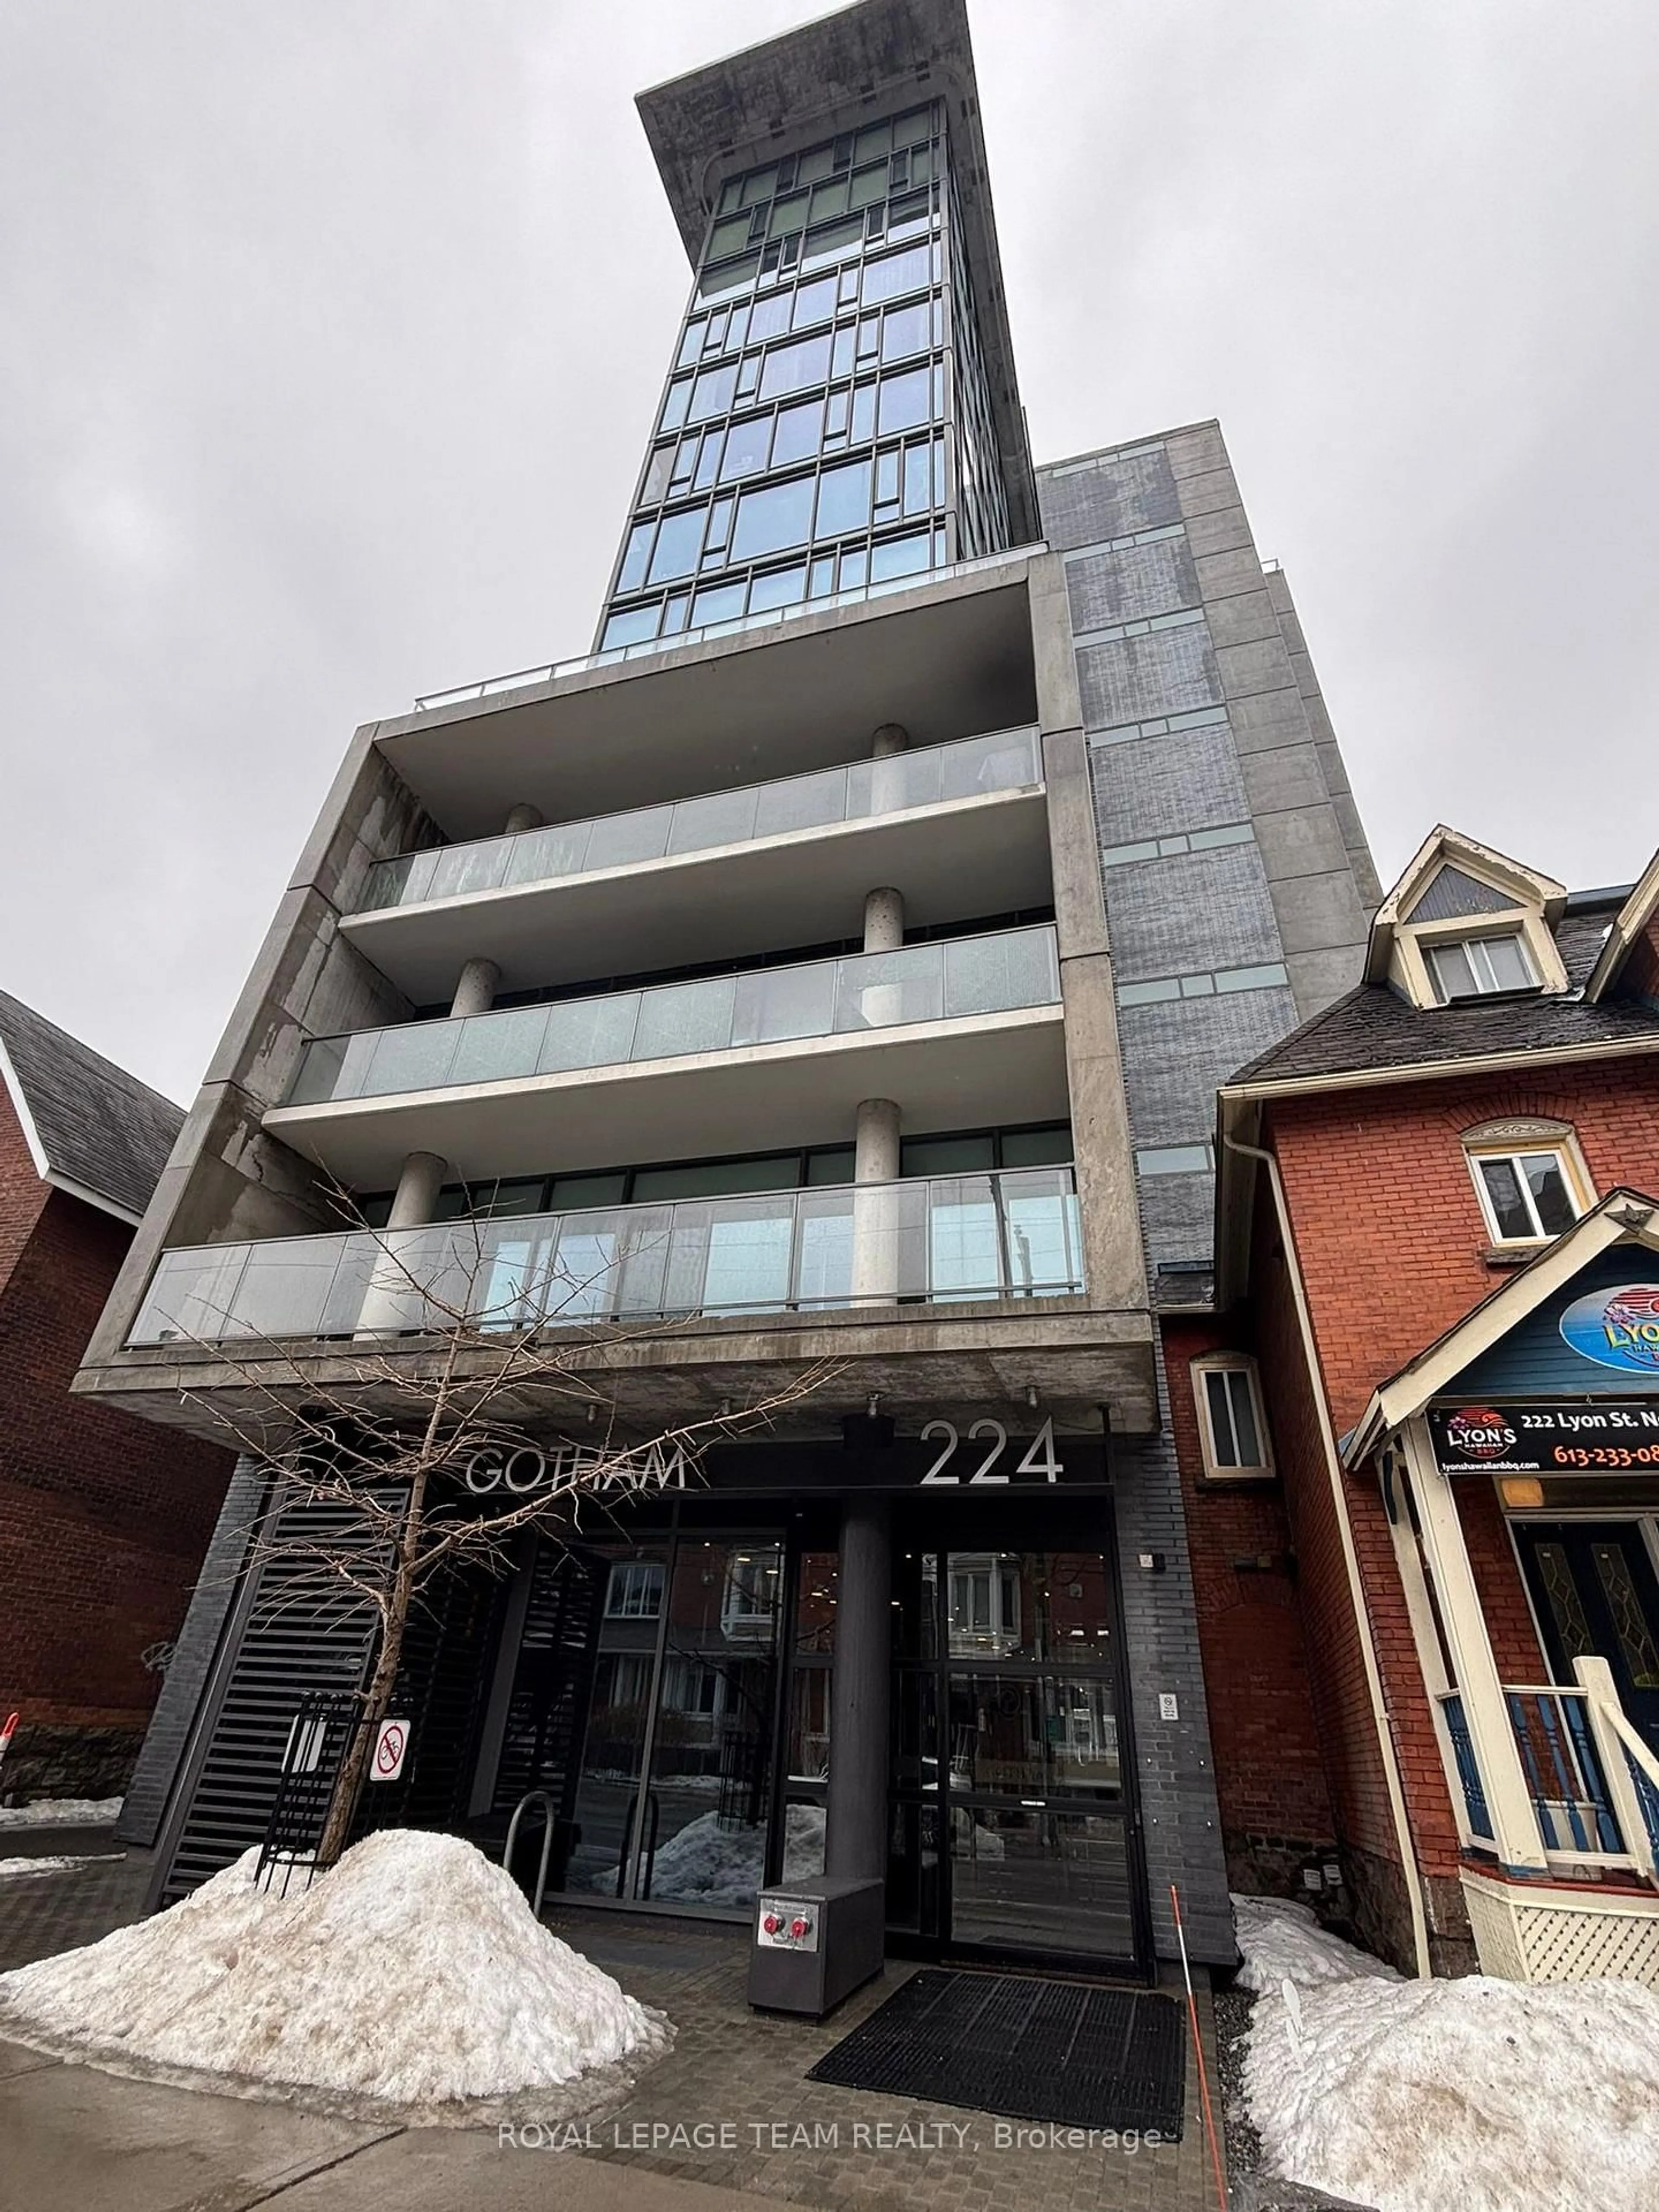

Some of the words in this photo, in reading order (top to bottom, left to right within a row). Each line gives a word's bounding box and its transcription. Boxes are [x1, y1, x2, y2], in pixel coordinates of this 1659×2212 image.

[1447, 1428, 1518, 1446] LYON'S
[1521, 1415, 1555, 1428] 222
[1557, 1412, 1607, 1432] Lyon
[1609, 1411, 1639, 1427] St.
[1640, 1411, 1659, 1427] N
[920, 1415, 1064, 1484] 224
[466, 1444, 685, 1494] GOTHAM
